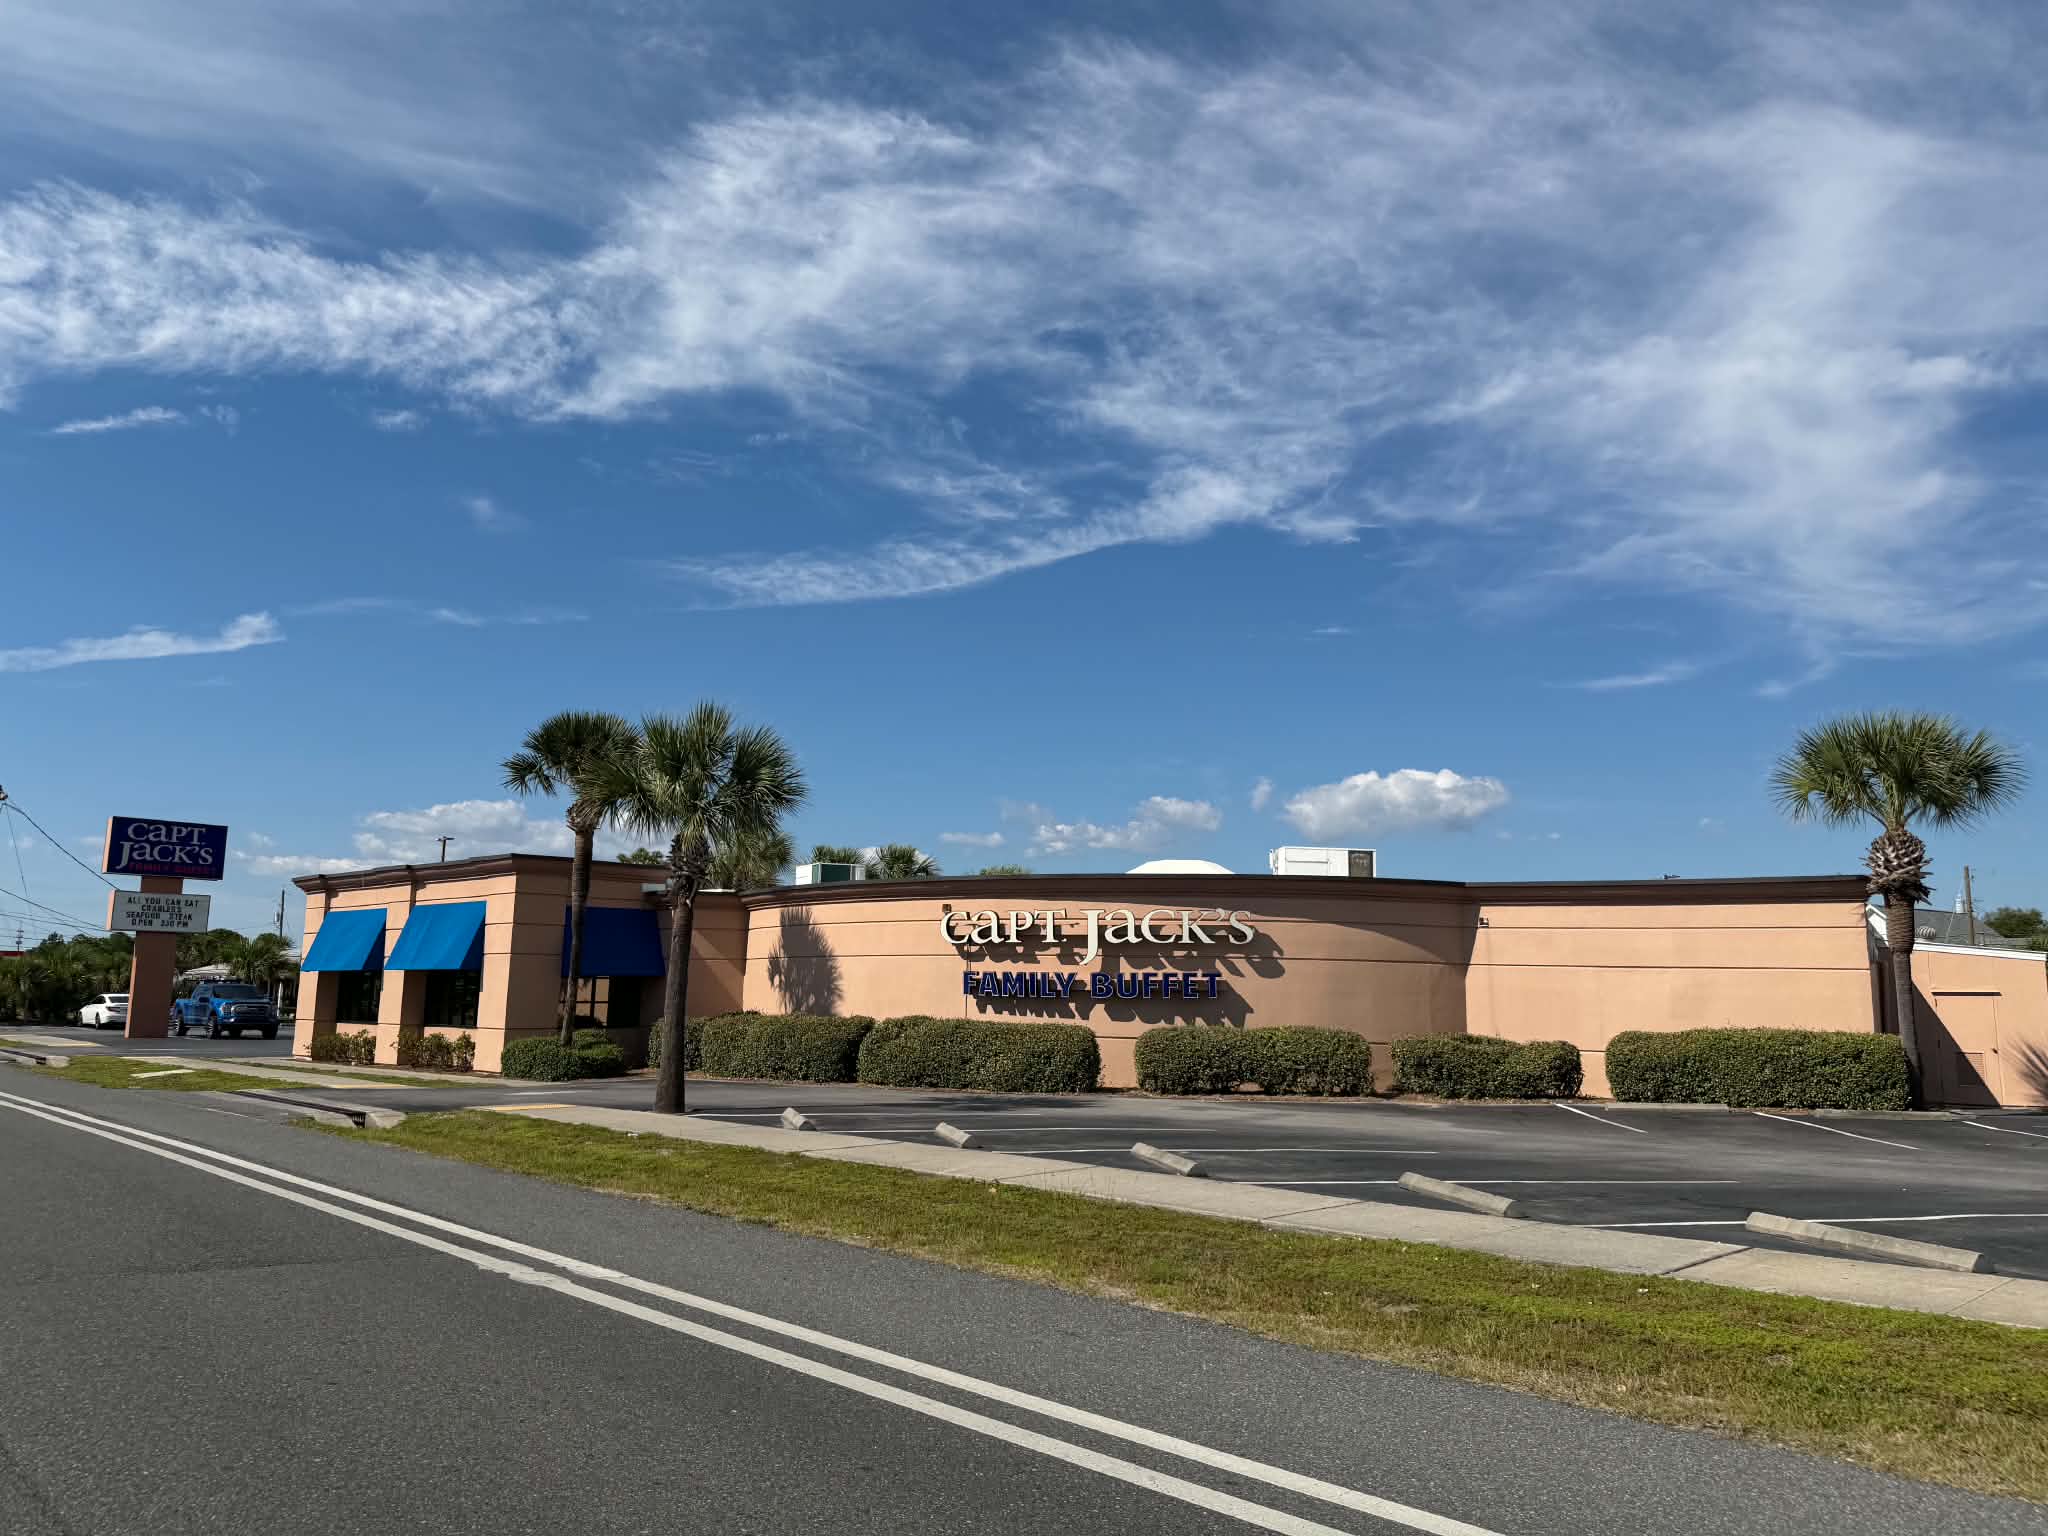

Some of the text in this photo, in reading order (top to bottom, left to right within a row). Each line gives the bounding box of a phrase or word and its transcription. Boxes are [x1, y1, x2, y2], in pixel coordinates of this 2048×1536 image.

[145, 897, 160, 905] YOU
[166, 898, 181, 906] CAN
[184, 899, 199, 908] EAT
[126, 911, 192, 921] SEAFOOD STEAK
[131, 918, 152, 927] OPEN
[176, 920, 188, 928] PM
[963, 970, 1222, 1000] FAMILY BUFFET
